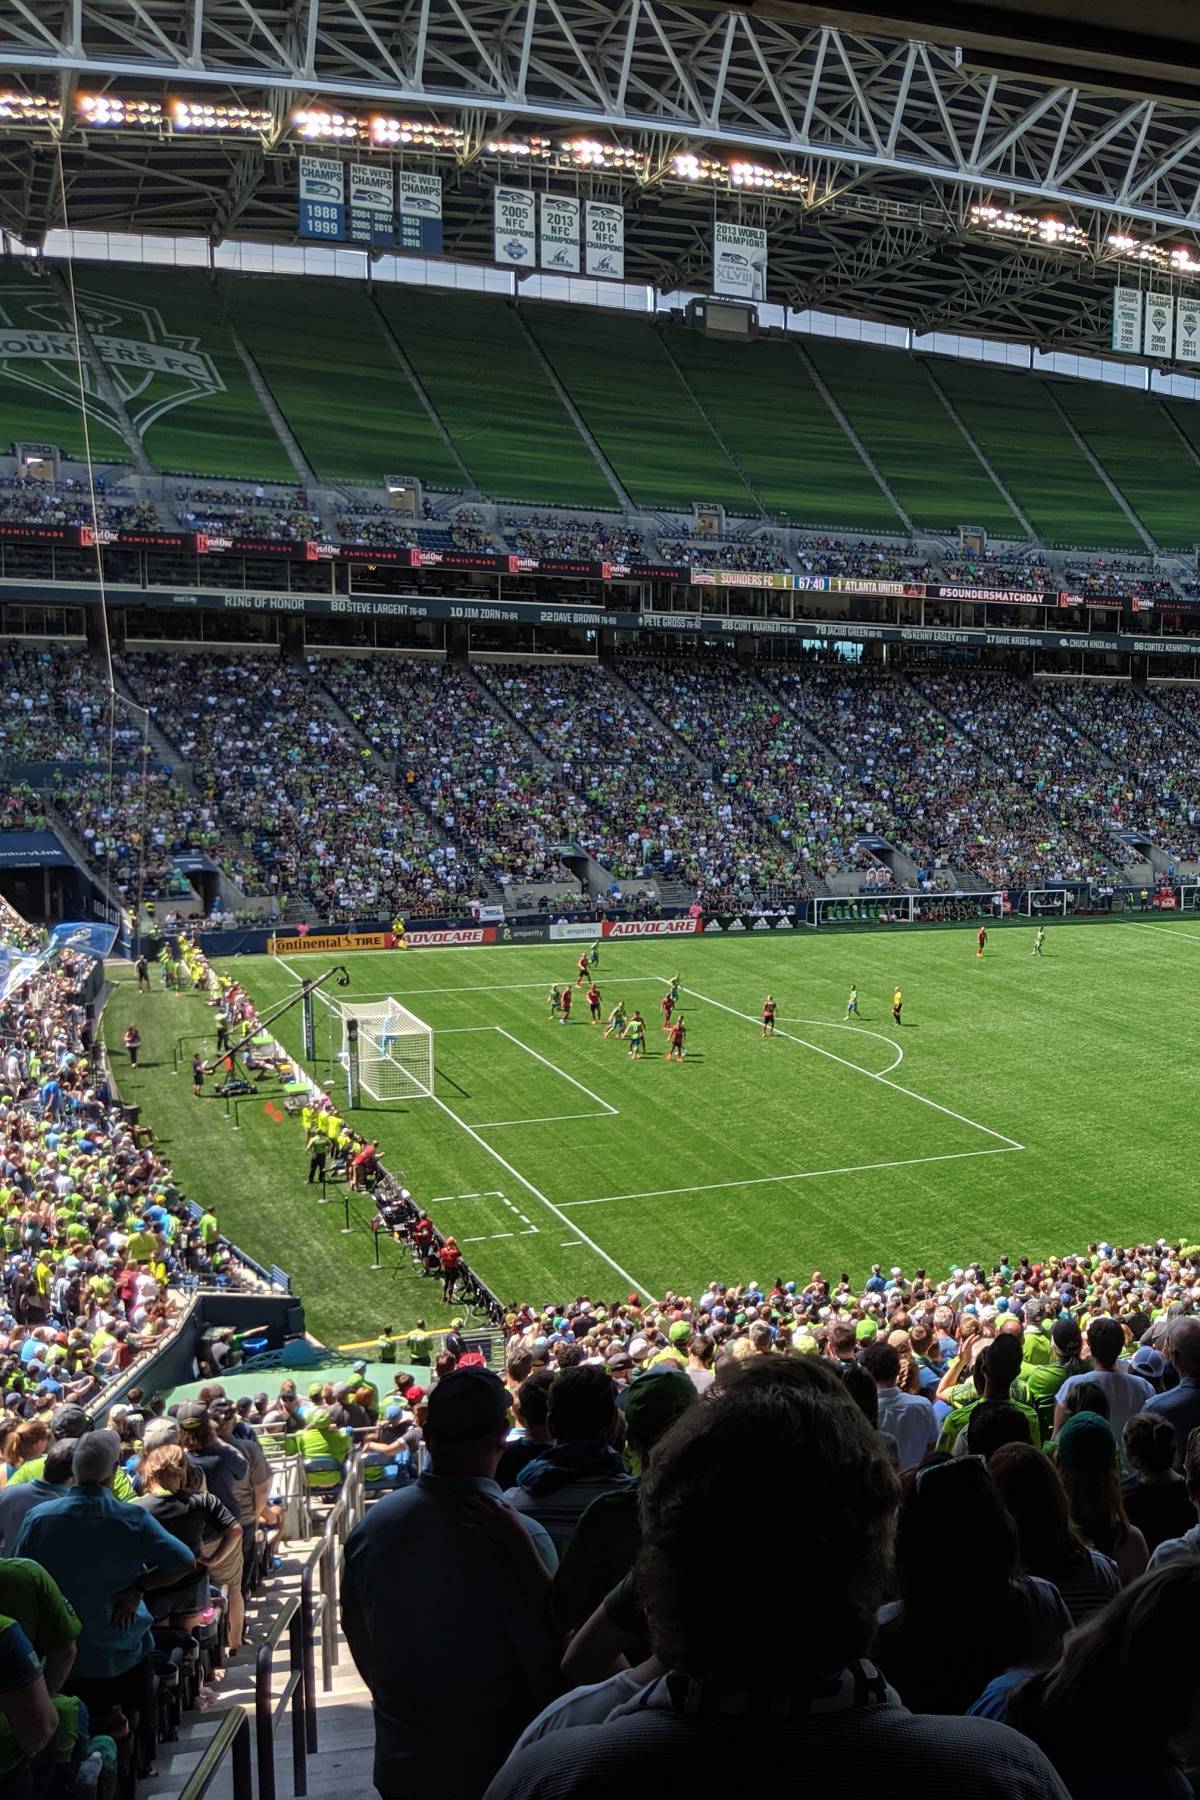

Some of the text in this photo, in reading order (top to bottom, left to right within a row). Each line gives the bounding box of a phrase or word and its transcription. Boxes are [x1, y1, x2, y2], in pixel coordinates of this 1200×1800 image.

[301, 159, 342, 172] AFC WEST
[301, 167, 342, 182] CHAMPS
[352, 166, 392, 180] NFC WEST
[352, 173, 392, 190] CHAMPS
[401, 173, 441, 187] NFC WEST
[401, 181, 440, 197] CHAMPS
[307, 204, 338, 220] 1988
[501, 205, 529, 219] 2005
[505, 217, 525, 229] NFC
[546, 212, 573, 227] 2013
[307, 219, 338, 235] 1999
[496, 226, 534, 239] CHAMPIONS
[550, 225, 570, 237] NFC
[591, 220, 618, 235] 2014
[716, 224, 765, 241] 2013 WORLD
[541, 233, 579, 247] CHAMPIONS
[595, 232, 614, 243] NFC
[716, 234, 765, 249] CHAMPIONS
[586, 240, 624, 253] CHAMPIONS
[1148, 299, 1171, 309] CHAMPS
[165, 357, 203, 378] FC
[1, 528, 64, 539] FAMILY MADE
[123, 536, 182, 546] FAMILY MADE
[720, 572, 788, 587] SOUNDERS FC 1
[799, 578, 825, 590] 67:40
[837, 580, 904, 595] 1 ATLANTA UNITED
[939, 587, 1045, 604] #SOUNDERSMATCHDAY
[224, 595, 305, 611] RING OF HONOR
[331, 601, 408, 616] 80 STEVE LARGENT
[450, 606, 501, 619] 10 JIM ZORN
[540, 611, 600, 624] 22 DAVE BROWN
[644, 616, 686, 628] PETE GROSS
[722, 620, 781, 633] 28 CURT WARNER
[815, 625, 869, 638] 79 JACOB GREEN
[901, 630, 956, 642] 45 KENNY EASLEY
[986, 635, 1030, 646] 17 DAVE KRIEG
[1069, 638, 1106, 649] CHUCK KNOX
[1134, 642, 1191, 653] 96 CORTEZ KENNEDY
[566, 927, 596, 937] amperity
[614, 921, 696, 934] ADVOCARE
[403, 930, 483, 944] ADVOCARE
[513, 930, 543, 939] amperity
[274, 936, 382, 951] Continental TIRE
